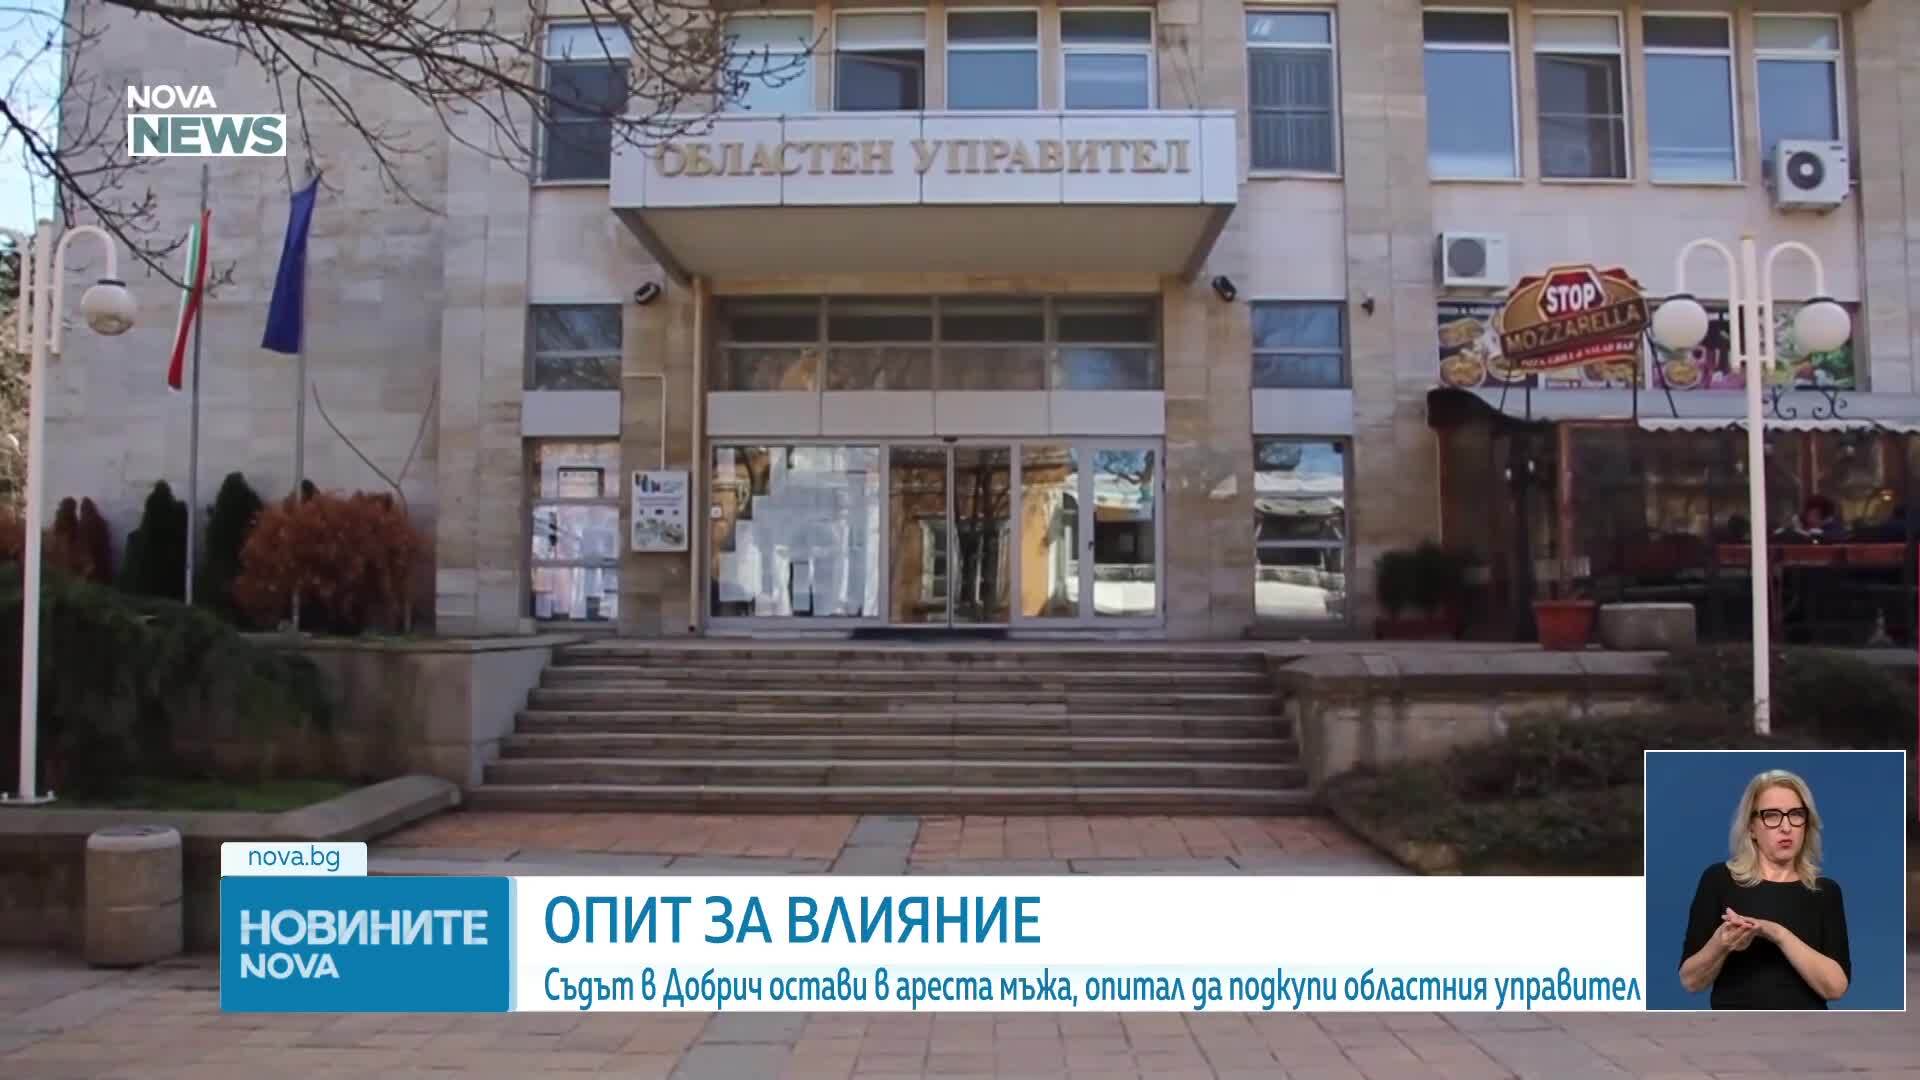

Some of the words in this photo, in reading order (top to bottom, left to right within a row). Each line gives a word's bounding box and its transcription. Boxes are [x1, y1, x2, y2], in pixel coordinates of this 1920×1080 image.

[656, 140, 894, 177] ОБЛАСТЕН
[911, 138, 1191, 175] УПРАВИТЕЛ
[1546, 283, 1596, 313] STOP
[1504, 303, 1641, 349] MOZZARELLA
